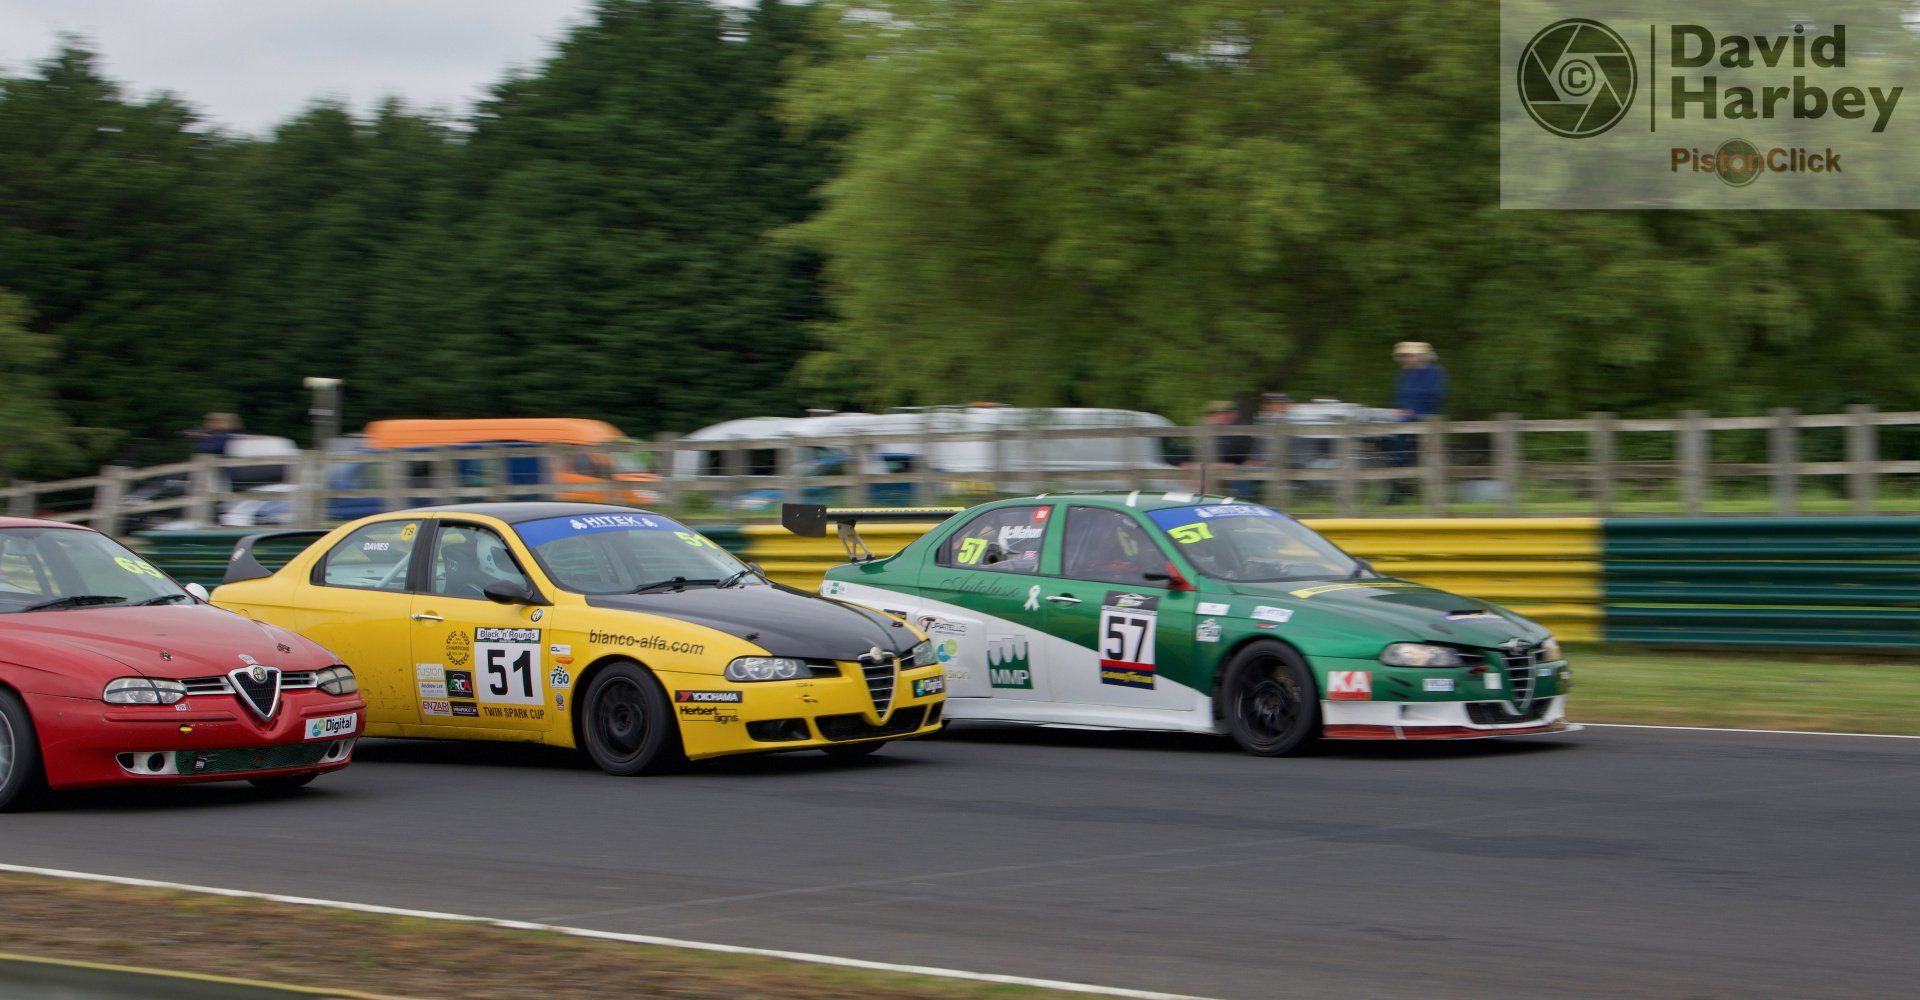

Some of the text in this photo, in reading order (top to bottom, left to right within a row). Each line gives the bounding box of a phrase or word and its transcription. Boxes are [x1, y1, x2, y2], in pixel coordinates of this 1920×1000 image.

[582, 516, 641, 526] HITEK
[404, 527, 415, 537] TS
[999, 525, 1043, 539] McMahon
[1168, 522, 1214, 544] 57
[363, 542, 390, 551] DAVIES
[673, 531, 718, 549] 51
[958, 538, 988, 565] 57
[113, 557, 164, 578] 65
[480, 630, 499, 639] Black
[508, 631, 536, 639] Rounds
[1107, 615, 1148, 663] 57
[589, 629, 704, 656] bianco-alfa.com
[487, 649, 534, 698] 51
[551, 673, 570, 685] 750
[991, 668, 1030, 685] MMP
[449, 678, 471, 691] ARCA
[1328, 671, 1371, 692] KA
[692, 692, 739, 702] YOKOHAMA
[483, 706, 503, 717] TWIN
[504, 707, 529, 719] SPARK
[530, 709, 545, 719] CUP
[680, 705, 718, 715] Herbert
[326, 715, 353, 734] Digital
[713, 715, 739, 724] signs
